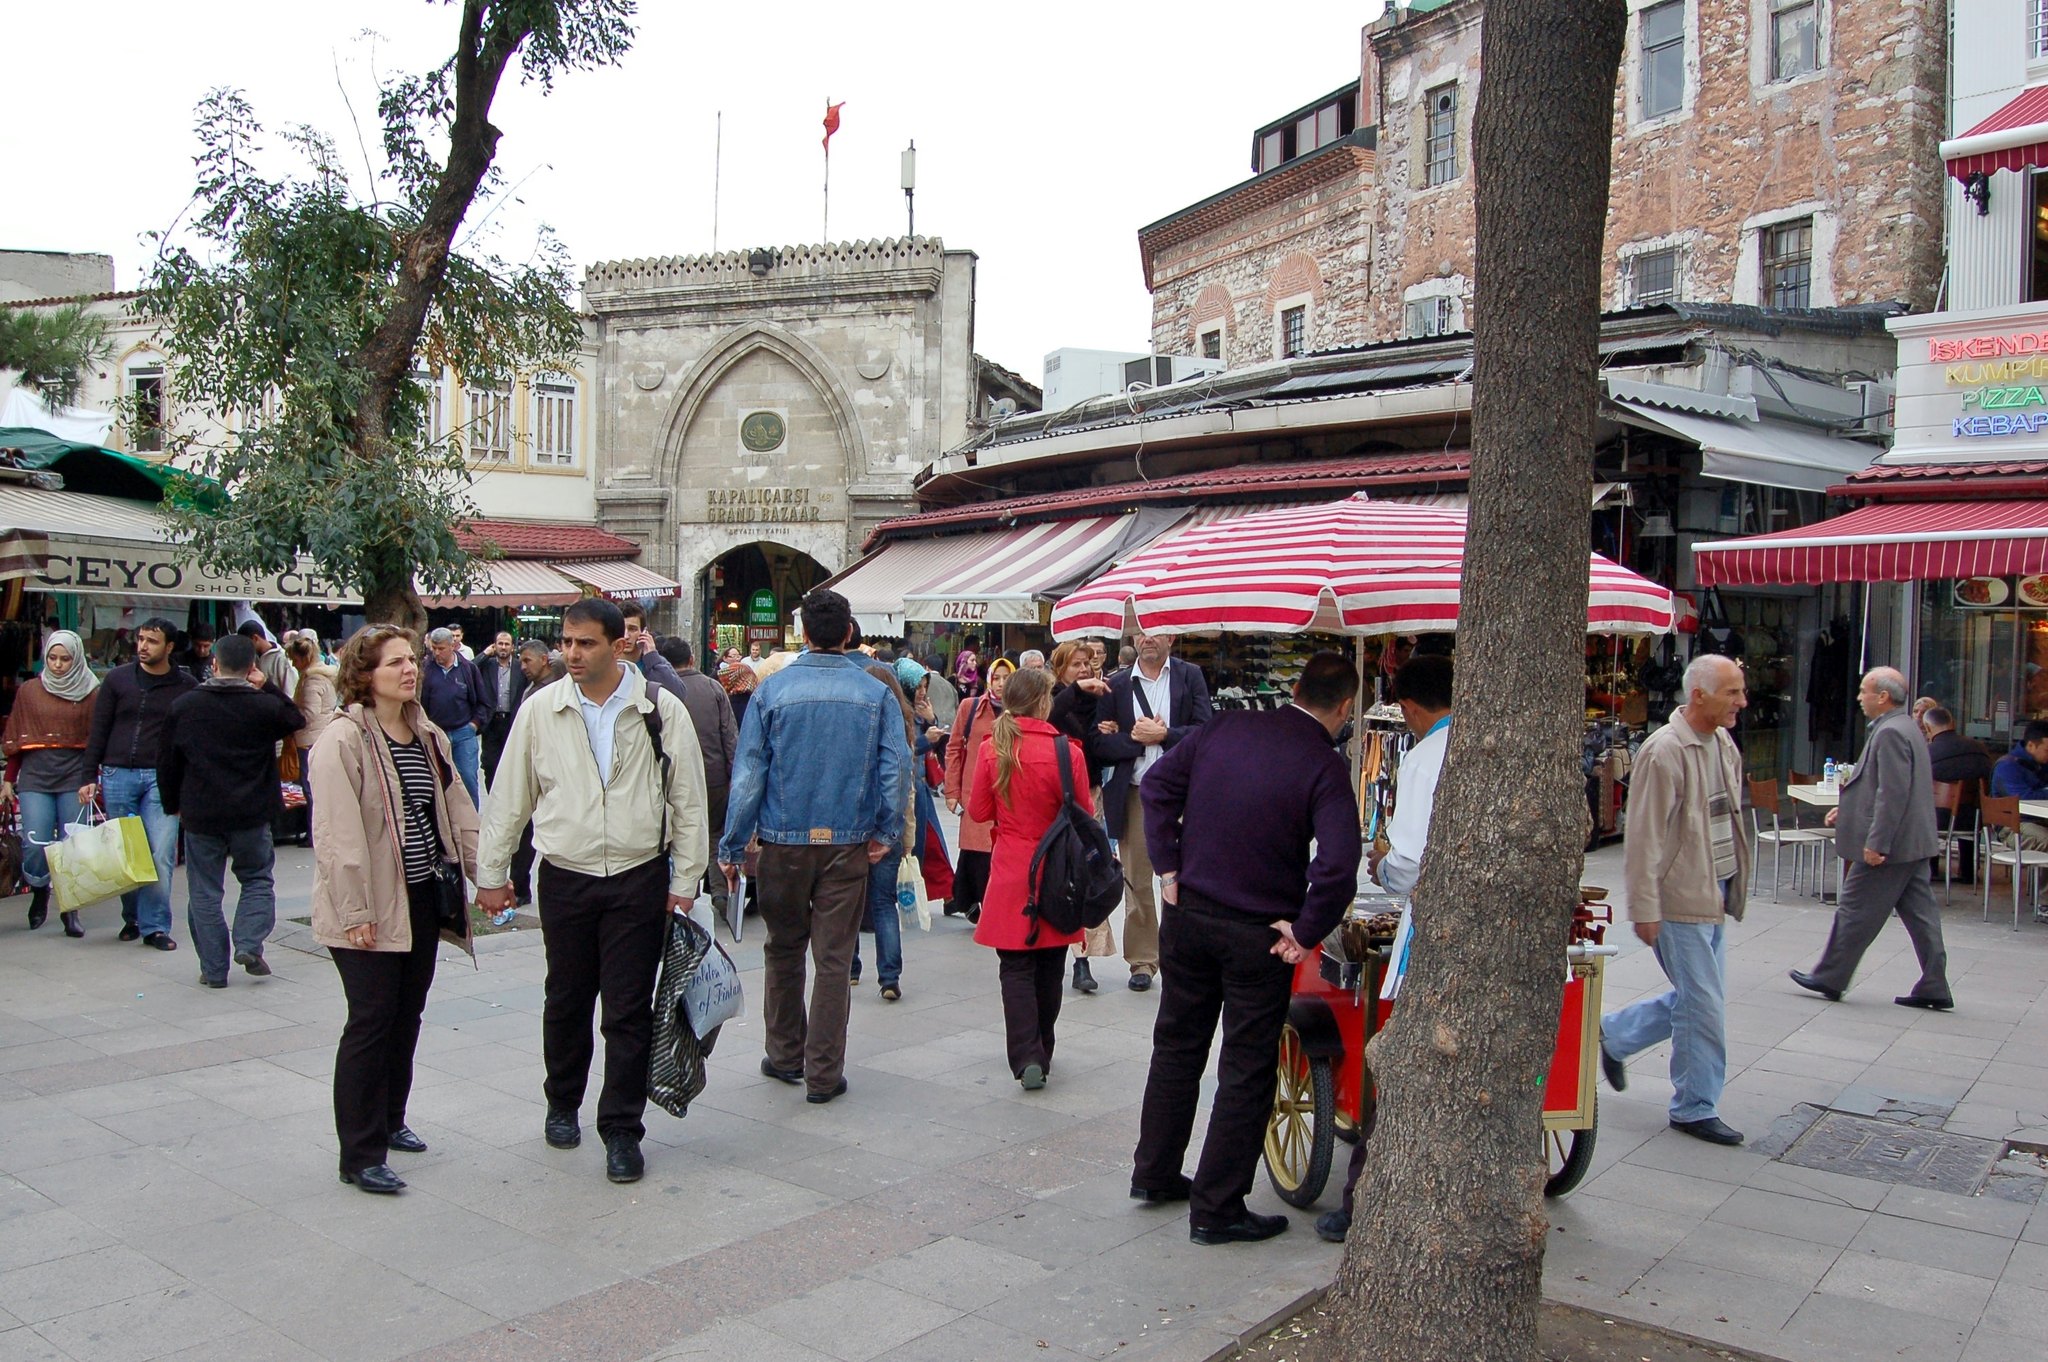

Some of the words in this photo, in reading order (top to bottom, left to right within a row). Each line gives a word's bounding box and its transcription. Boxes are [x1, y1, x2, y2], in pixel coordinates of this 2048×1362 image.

[707, 507, 756, 522] GRAND
[761, 506, 820, 522] BAZAAR
[194, 584, 266, 596] SHOES
